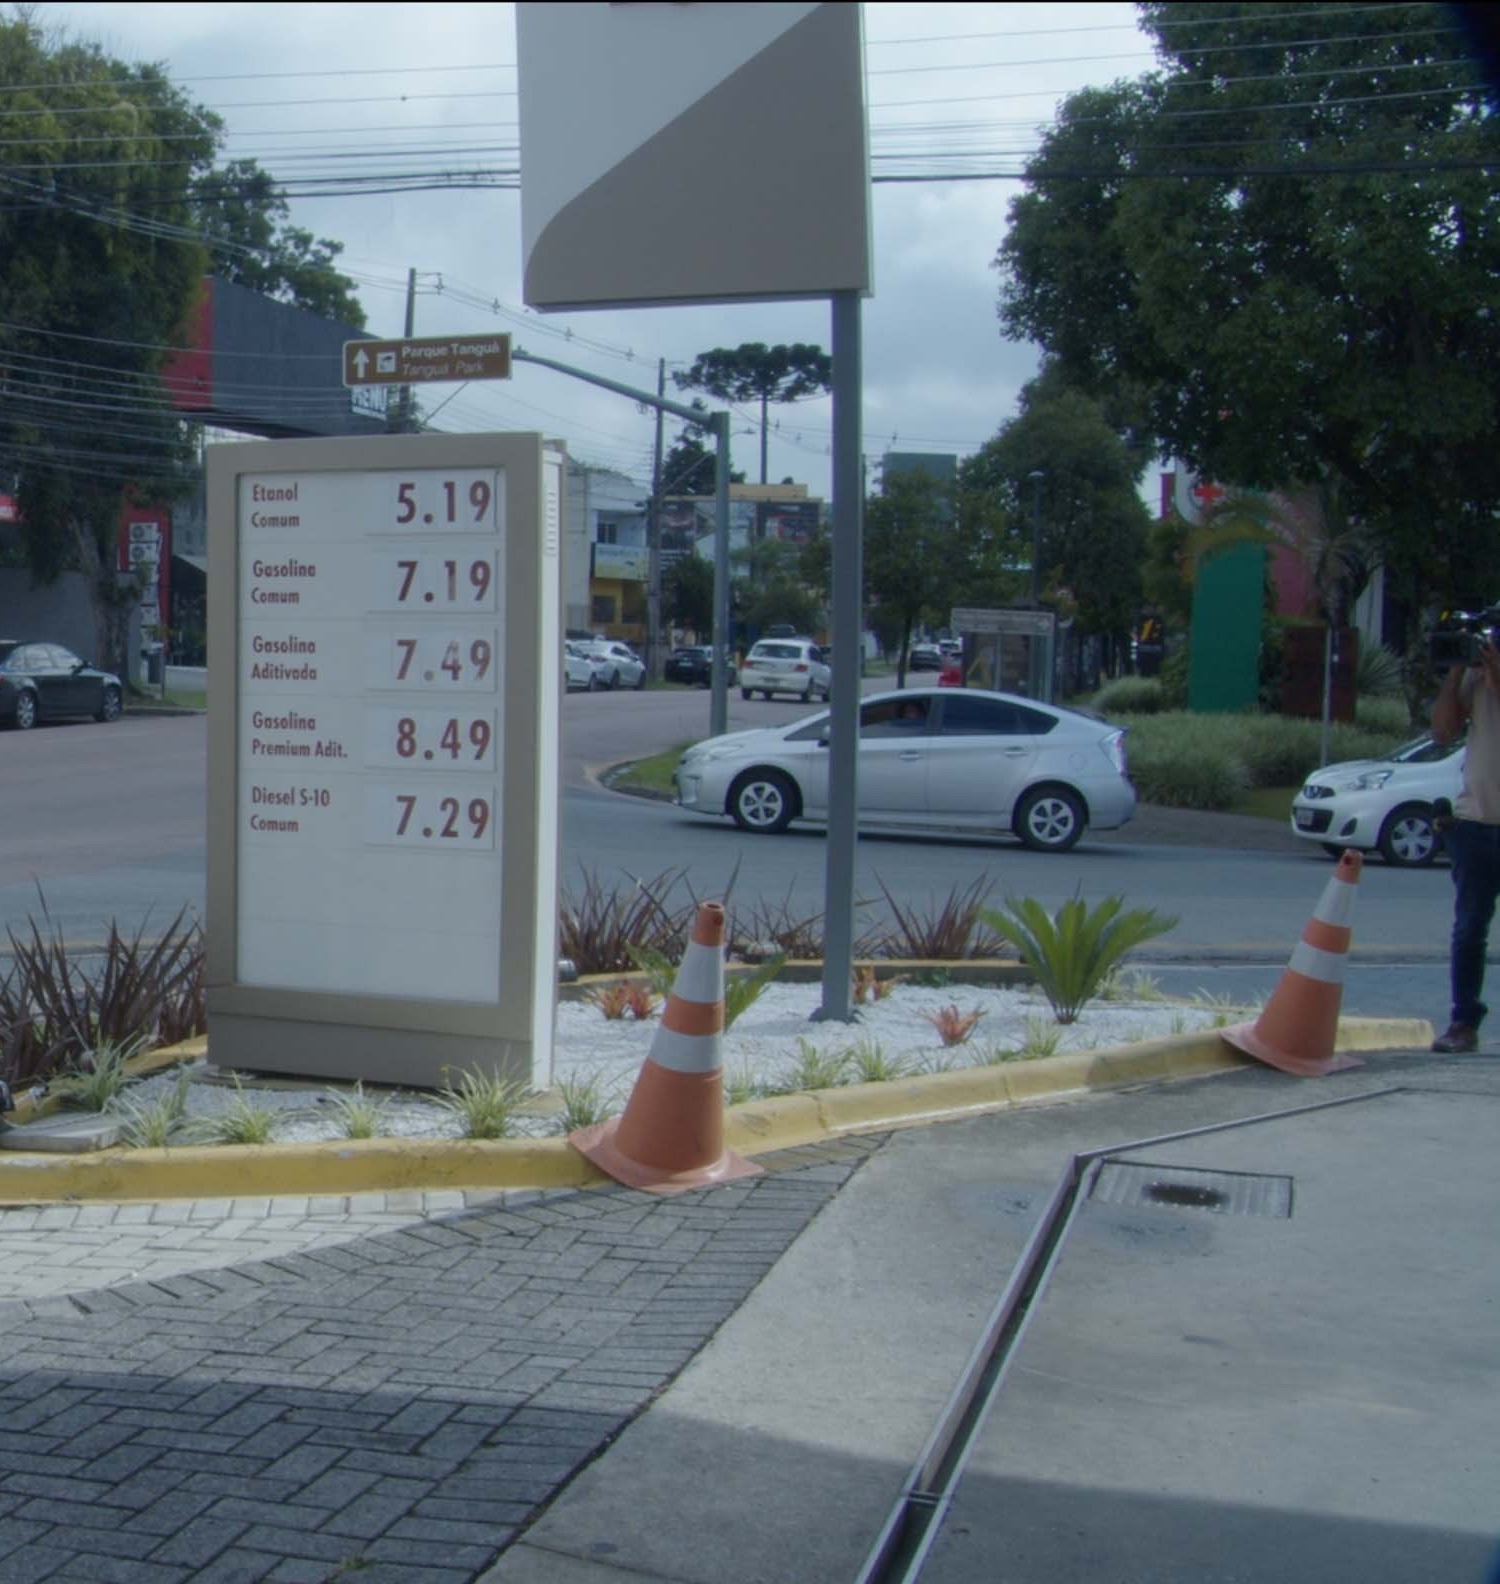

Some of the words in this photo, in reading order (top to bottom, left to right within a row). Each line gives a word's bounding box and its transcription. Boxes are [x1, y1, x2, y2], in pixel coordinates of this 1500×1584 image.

[402, 345, 448, 359] Parque
[455, 359, 485, 374] Park
[253, 483, 298, 502] Etanol
[397, 481, 491, 523] 5.19
[251, 512, 300, 528] Comum
[253, 559, 316, 578] Gasolina
[397, 560, 491, 602] 7.19
[251, 587, 300, 604] Comum
[253, 635, 316, 654] Gasolina
[397, 640, 491, 681] 7.49
[251, 663, 317, 681] Aditivada
[253, 711, 316, 731] Gasolina
[252, 739, 311, 757] Premium
[314, 741, 348, 758] Adit.
[396, 718, 491, 760] 8.49
[252, 786, 295, 805] Diesel
[299, 788, 330, 807] S-10
[250, 814, 299, 832] Comum
[396, 795, 489, 839] 7.29
